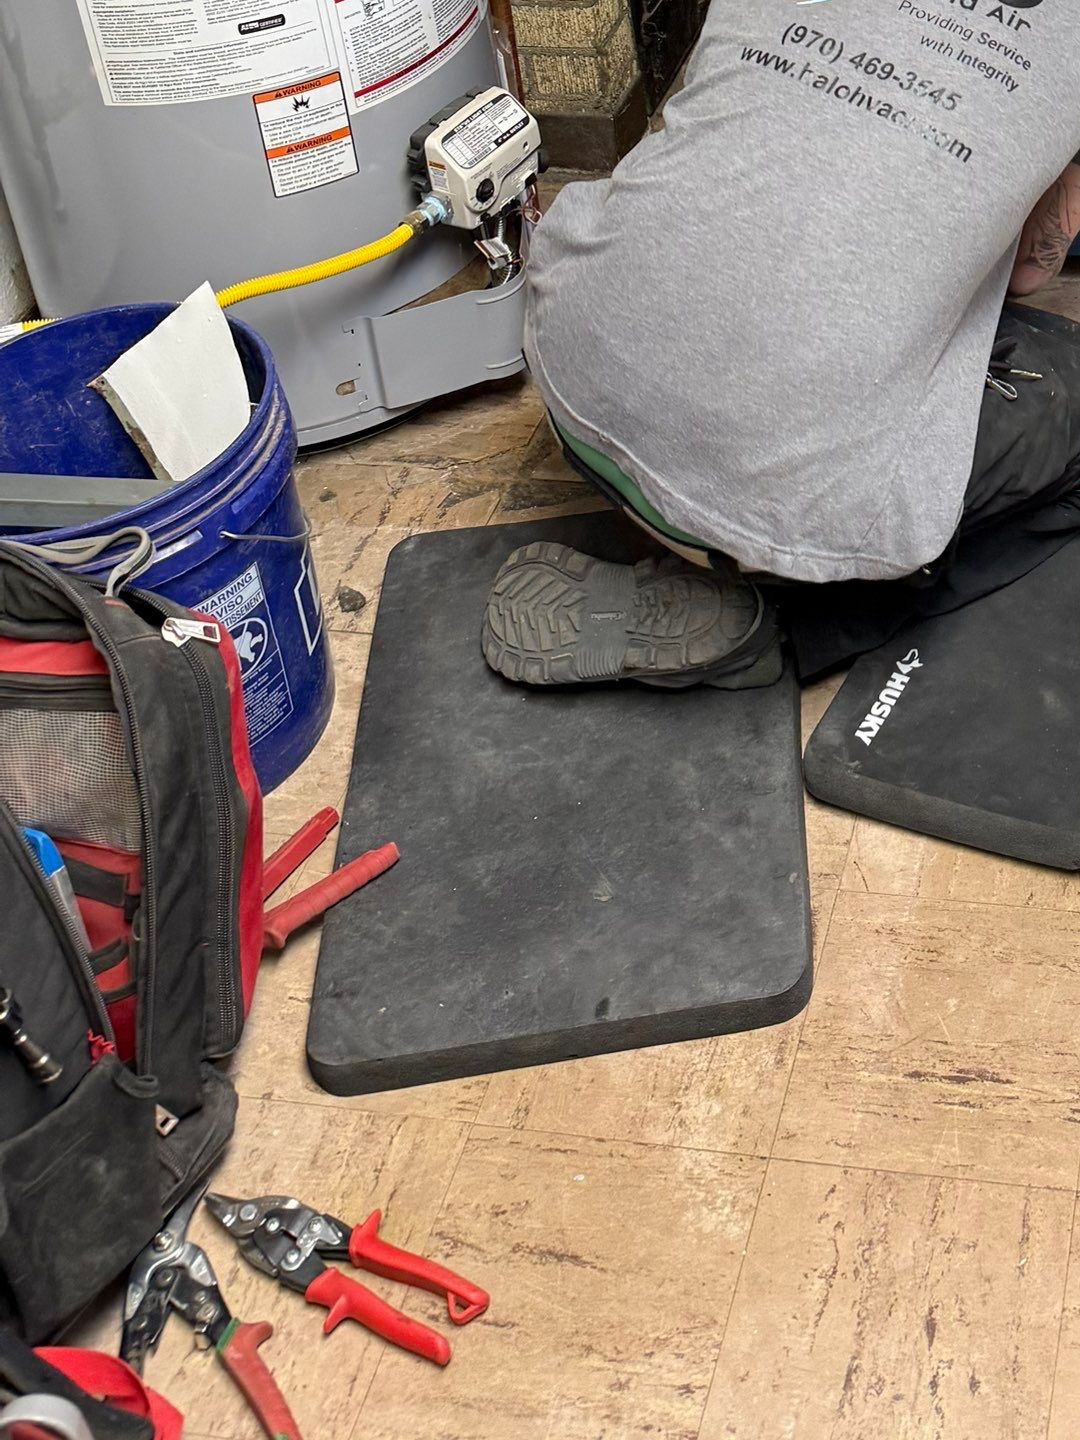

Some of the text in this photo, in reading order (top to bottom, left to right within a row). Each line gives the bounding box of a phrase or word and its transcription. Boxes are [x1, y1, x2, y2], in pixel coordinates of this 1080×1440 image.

[897, 0, 1032, 72] Providing Service
[986, 5, 1032, 32] Air
[781, 22, 963, 113] (970) 469-3545
[920, 34, 1021, 93] with Integrity
[282, 80, 322, 96] WARNING
[295, 134, 333, 151] WARNING
[197, 572, 253, 614] WARNING
[221, 591, 262, 627] TISSEMENT
[854, 671, 911, 746] HUSKY
